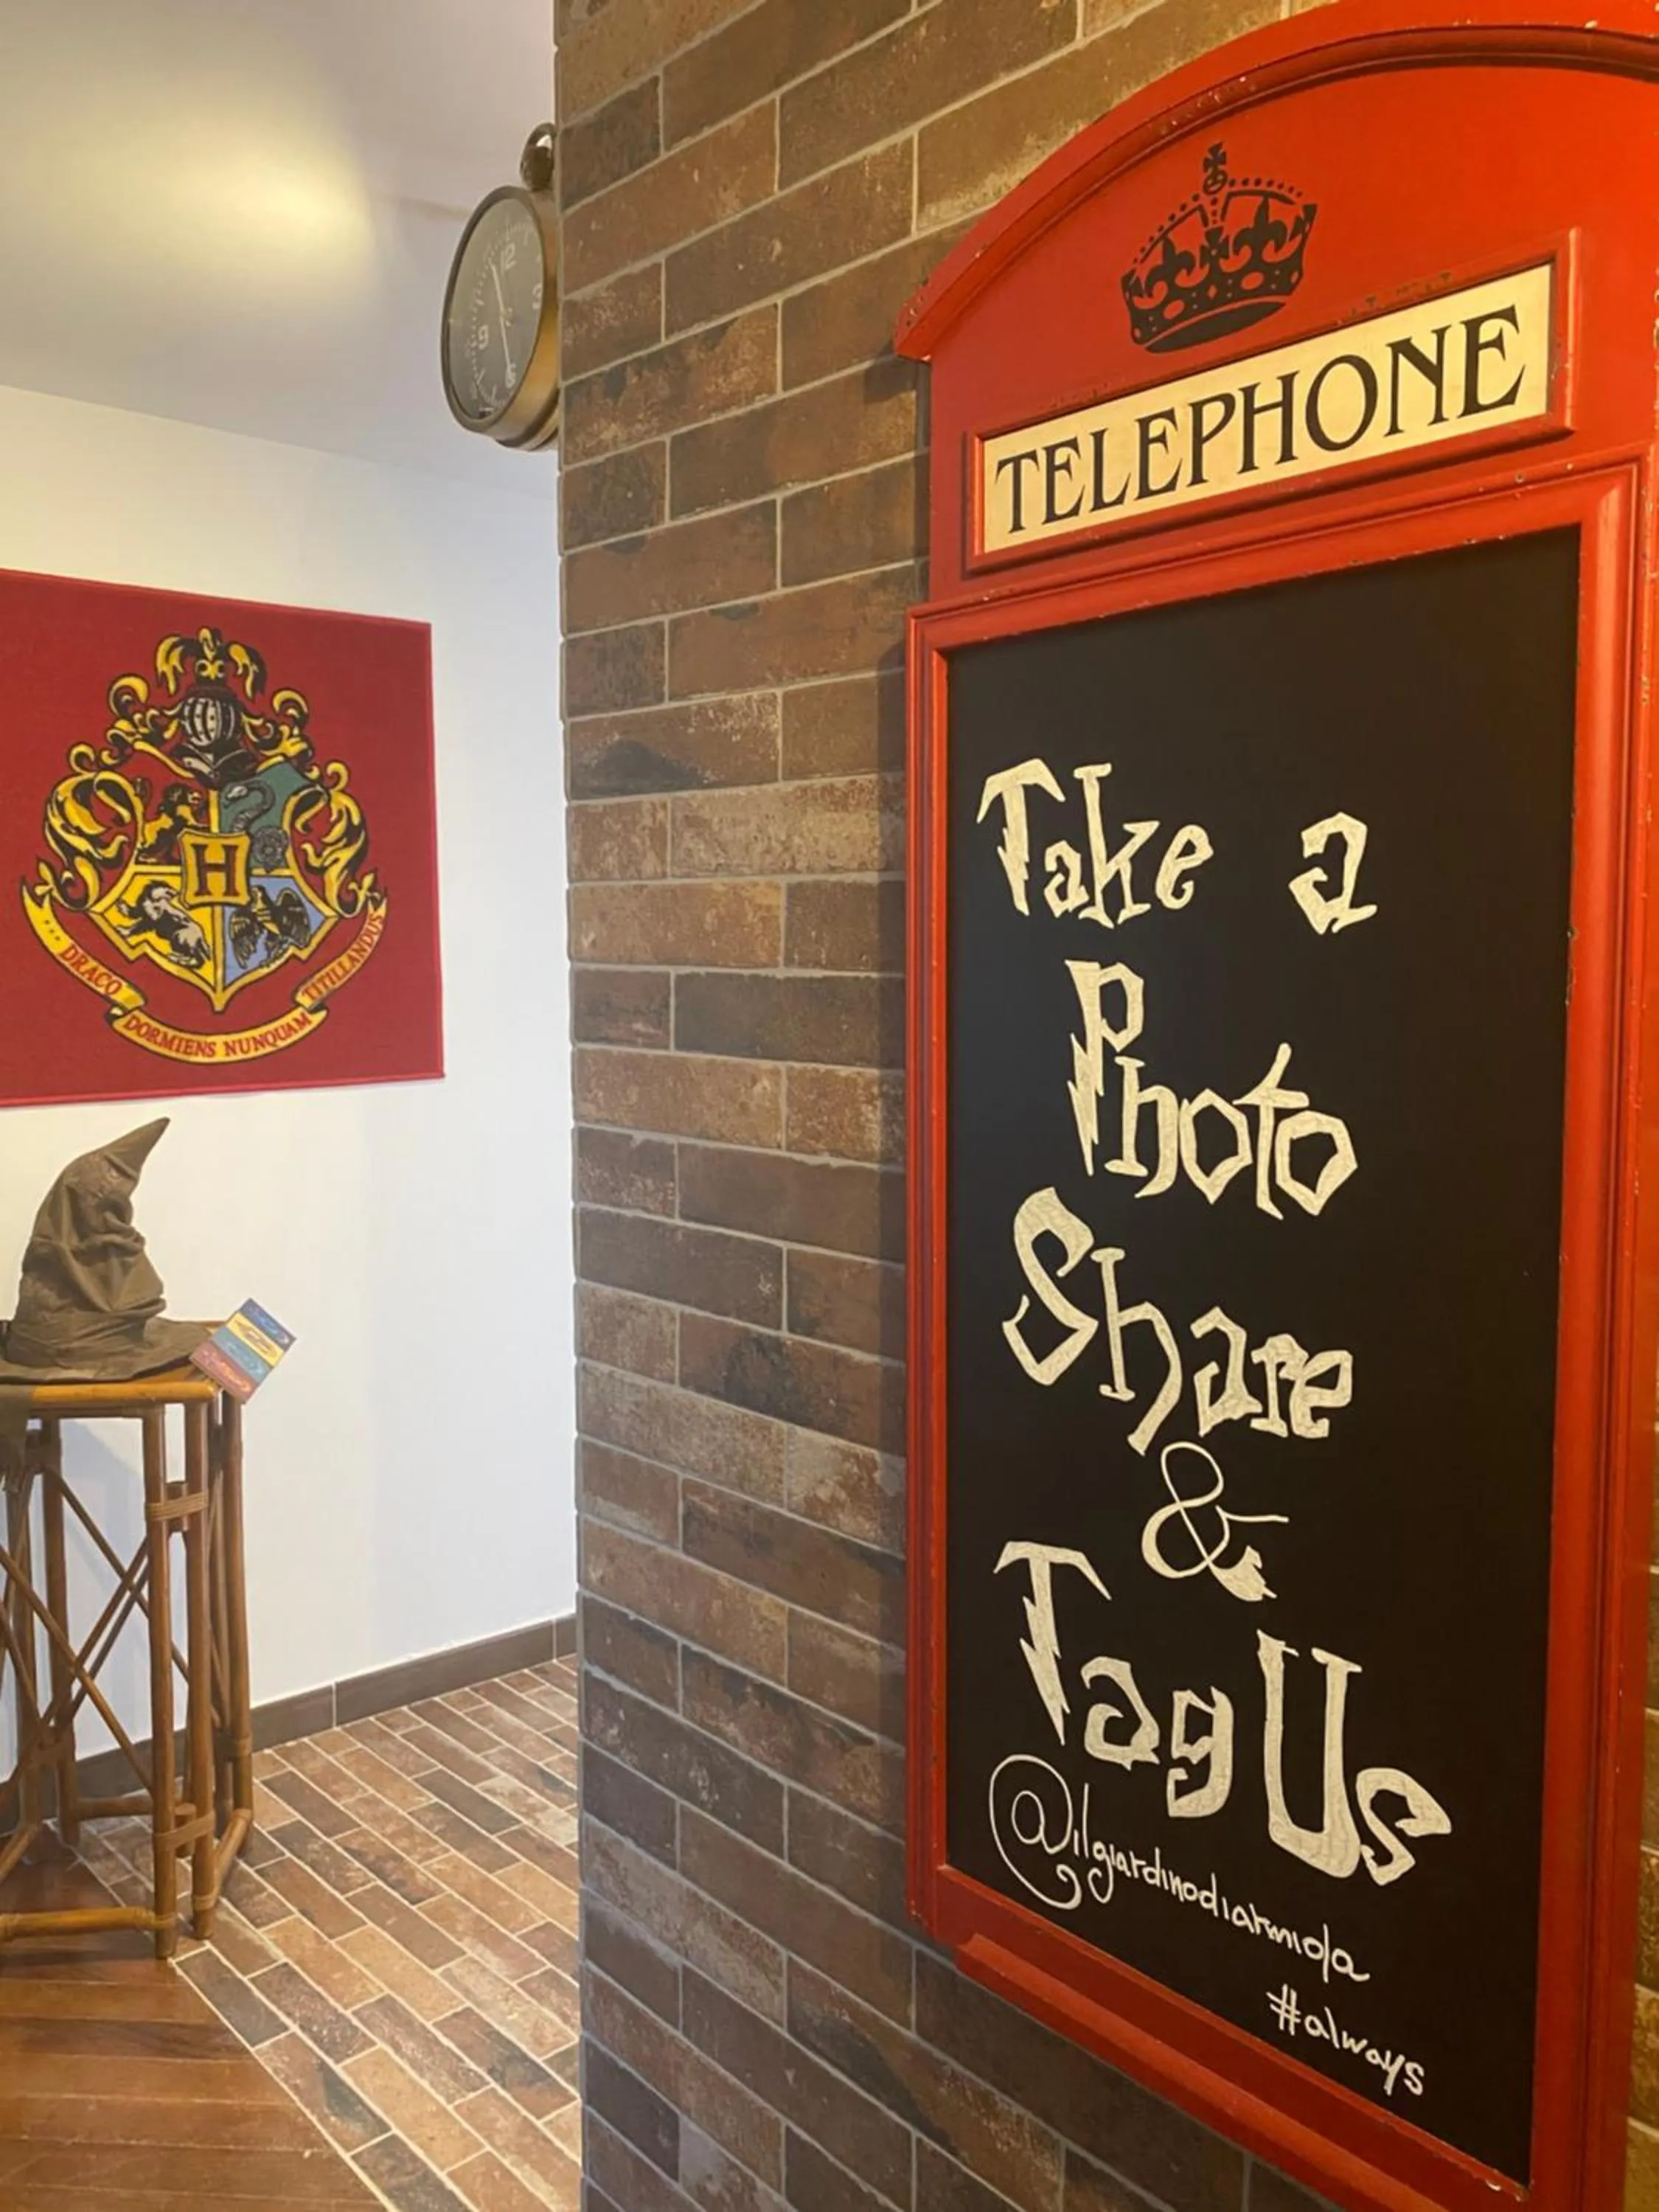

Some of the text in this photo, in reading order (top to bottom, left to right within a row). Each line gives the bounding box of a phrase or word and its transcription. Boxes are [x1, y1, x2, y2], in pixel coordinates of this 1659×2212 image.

[995, 304, 1526, 534] TELEPHONE
[189, 843, 240, 897] H
[976, 759, 1377, 934] Take a
[59, 913, 383, 1057] DRACO DORMIENS NUNQUAM TITILLANDUS
[1065, 960, 1357, 1220] Photo
[1003, 1187, 1352, 1455] Share
[1142, 1442, 1289, 1601] &
[994, 1542, 1451, 1885] Tag Us
[1267, 1984, 1424, 2095] #always
